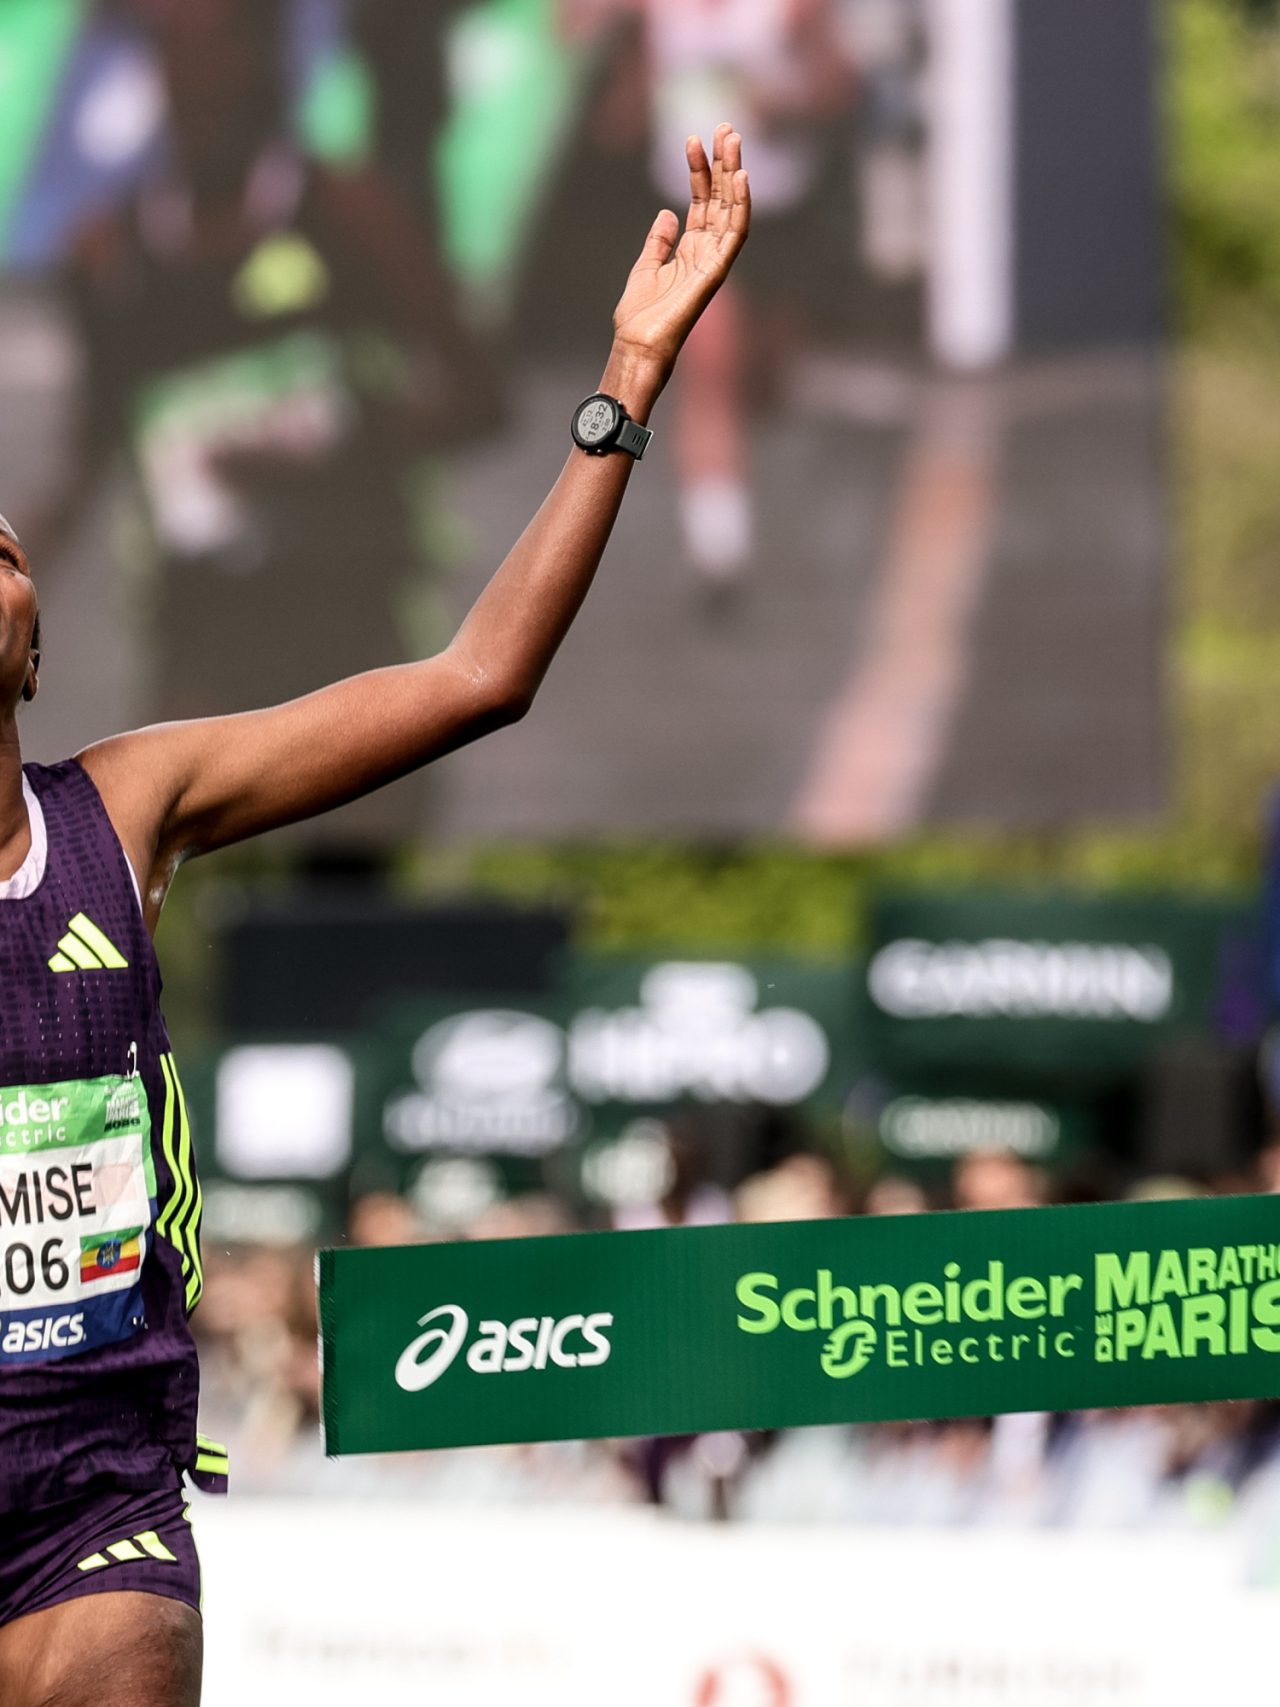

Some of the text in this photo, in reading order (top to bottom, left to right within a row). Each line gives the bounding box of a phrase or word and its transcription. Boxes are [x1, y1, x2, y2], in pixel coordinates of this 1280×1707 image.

[588, 403, 608, 436] 18:32
[735, 1260, 1084, 1334] Schneider
[886, 1324, 1076, 1367] Electric
[1095, 1313, 1114, 1363] DE
